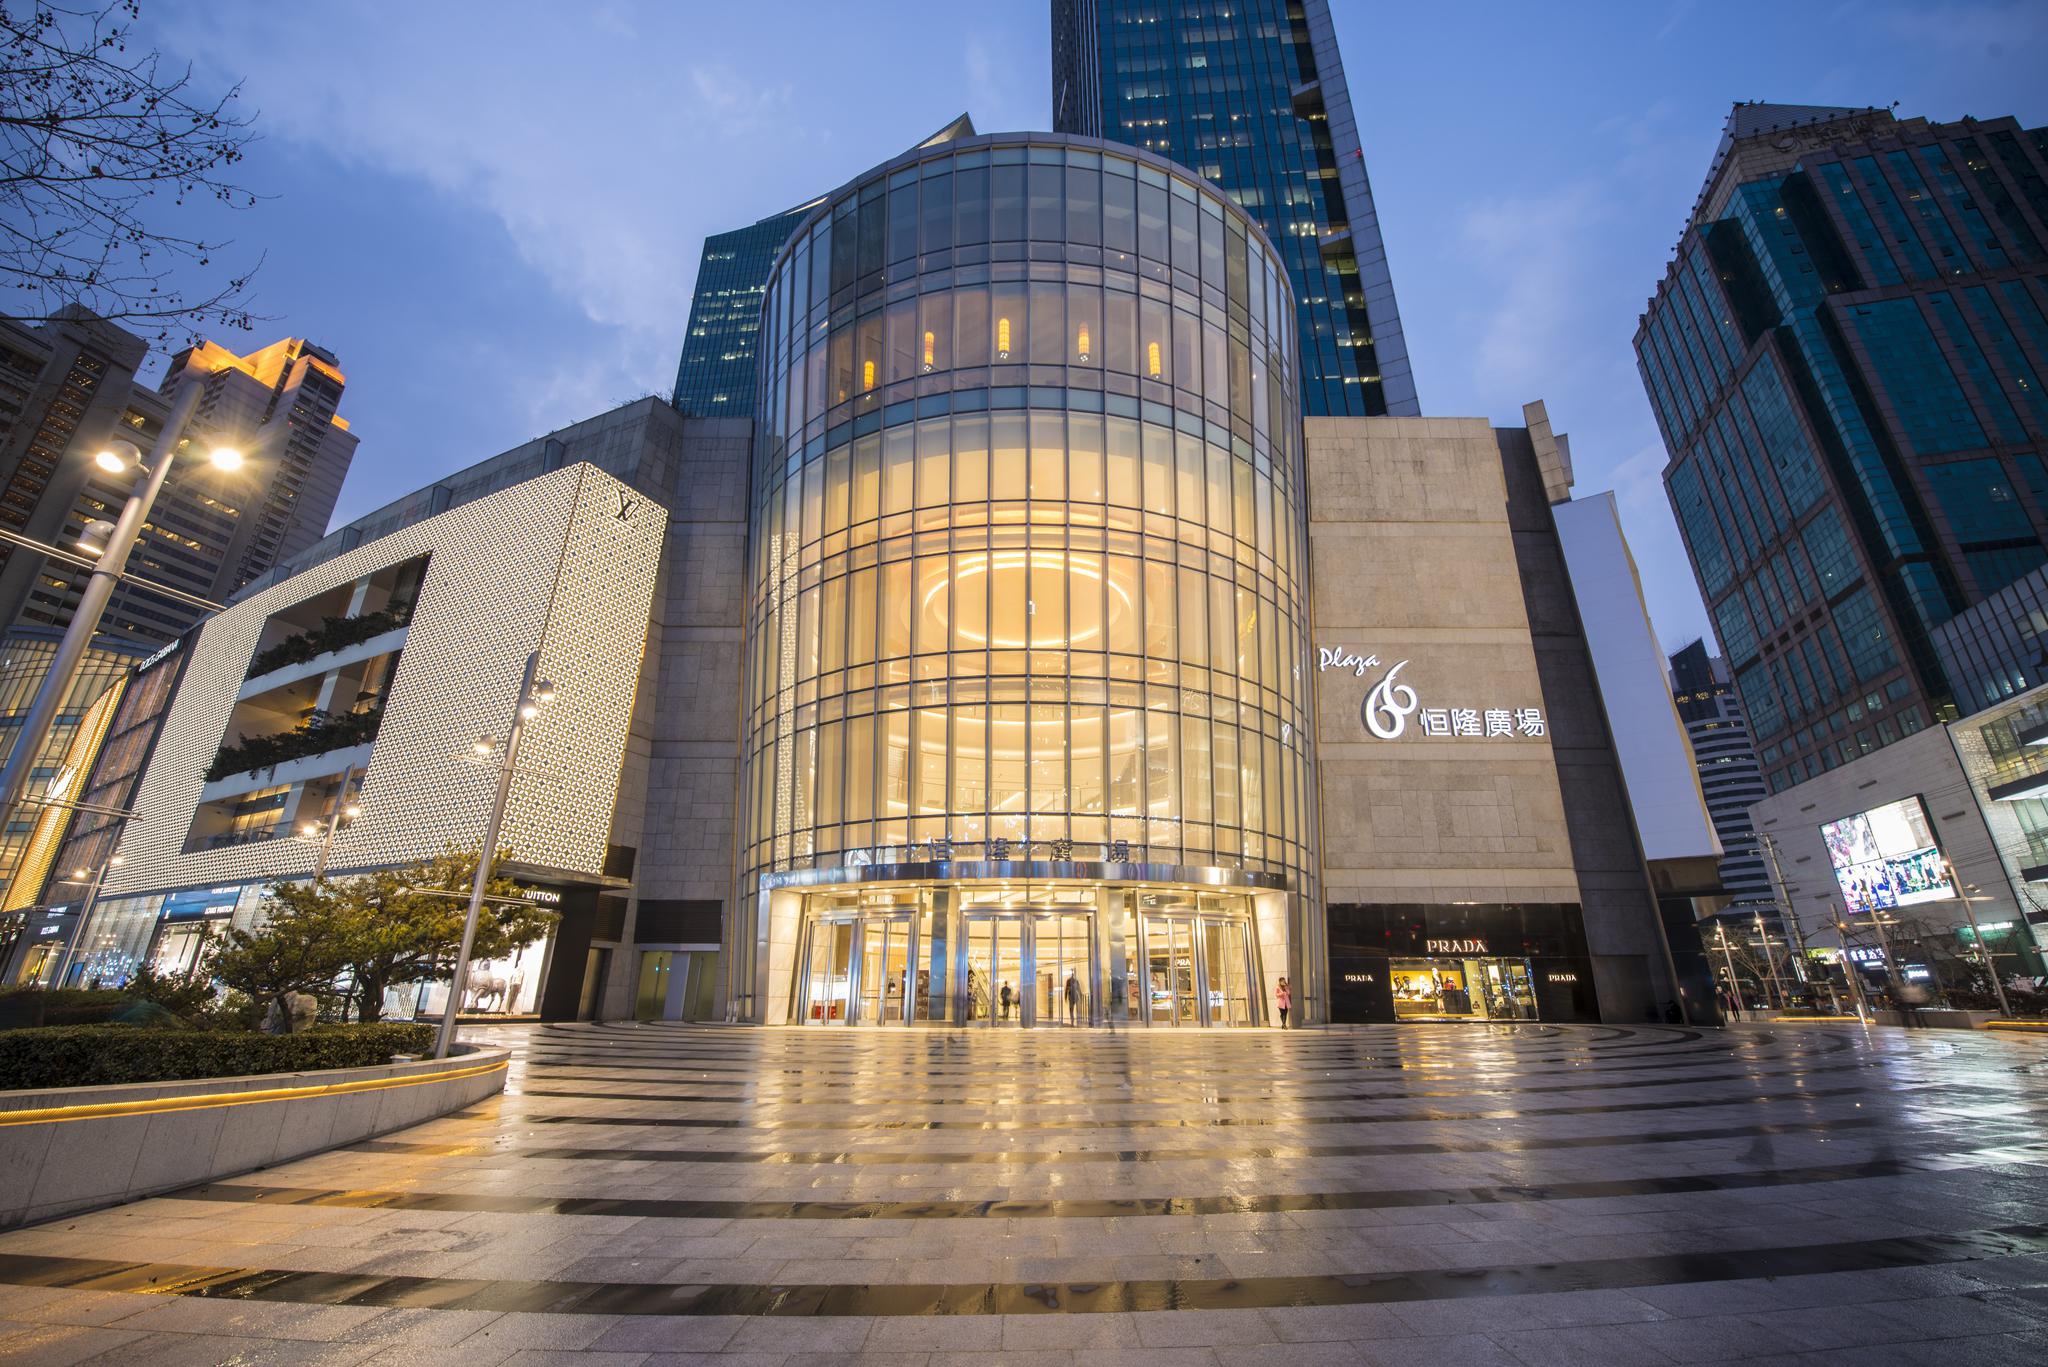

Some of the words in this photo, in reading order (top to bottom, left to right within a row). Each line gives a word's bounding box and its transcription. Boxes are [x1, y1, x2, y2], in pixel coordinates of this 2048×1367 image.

[1319, 646, 1382, 677] Plaza
[1418, 707, 1545, 738] 恒隆廣場
[1426, 939, 1489, 953] PRADA
[1344, 974, 1374, 982] PRADA
[1548, 973, 1578, 982] PRADA
